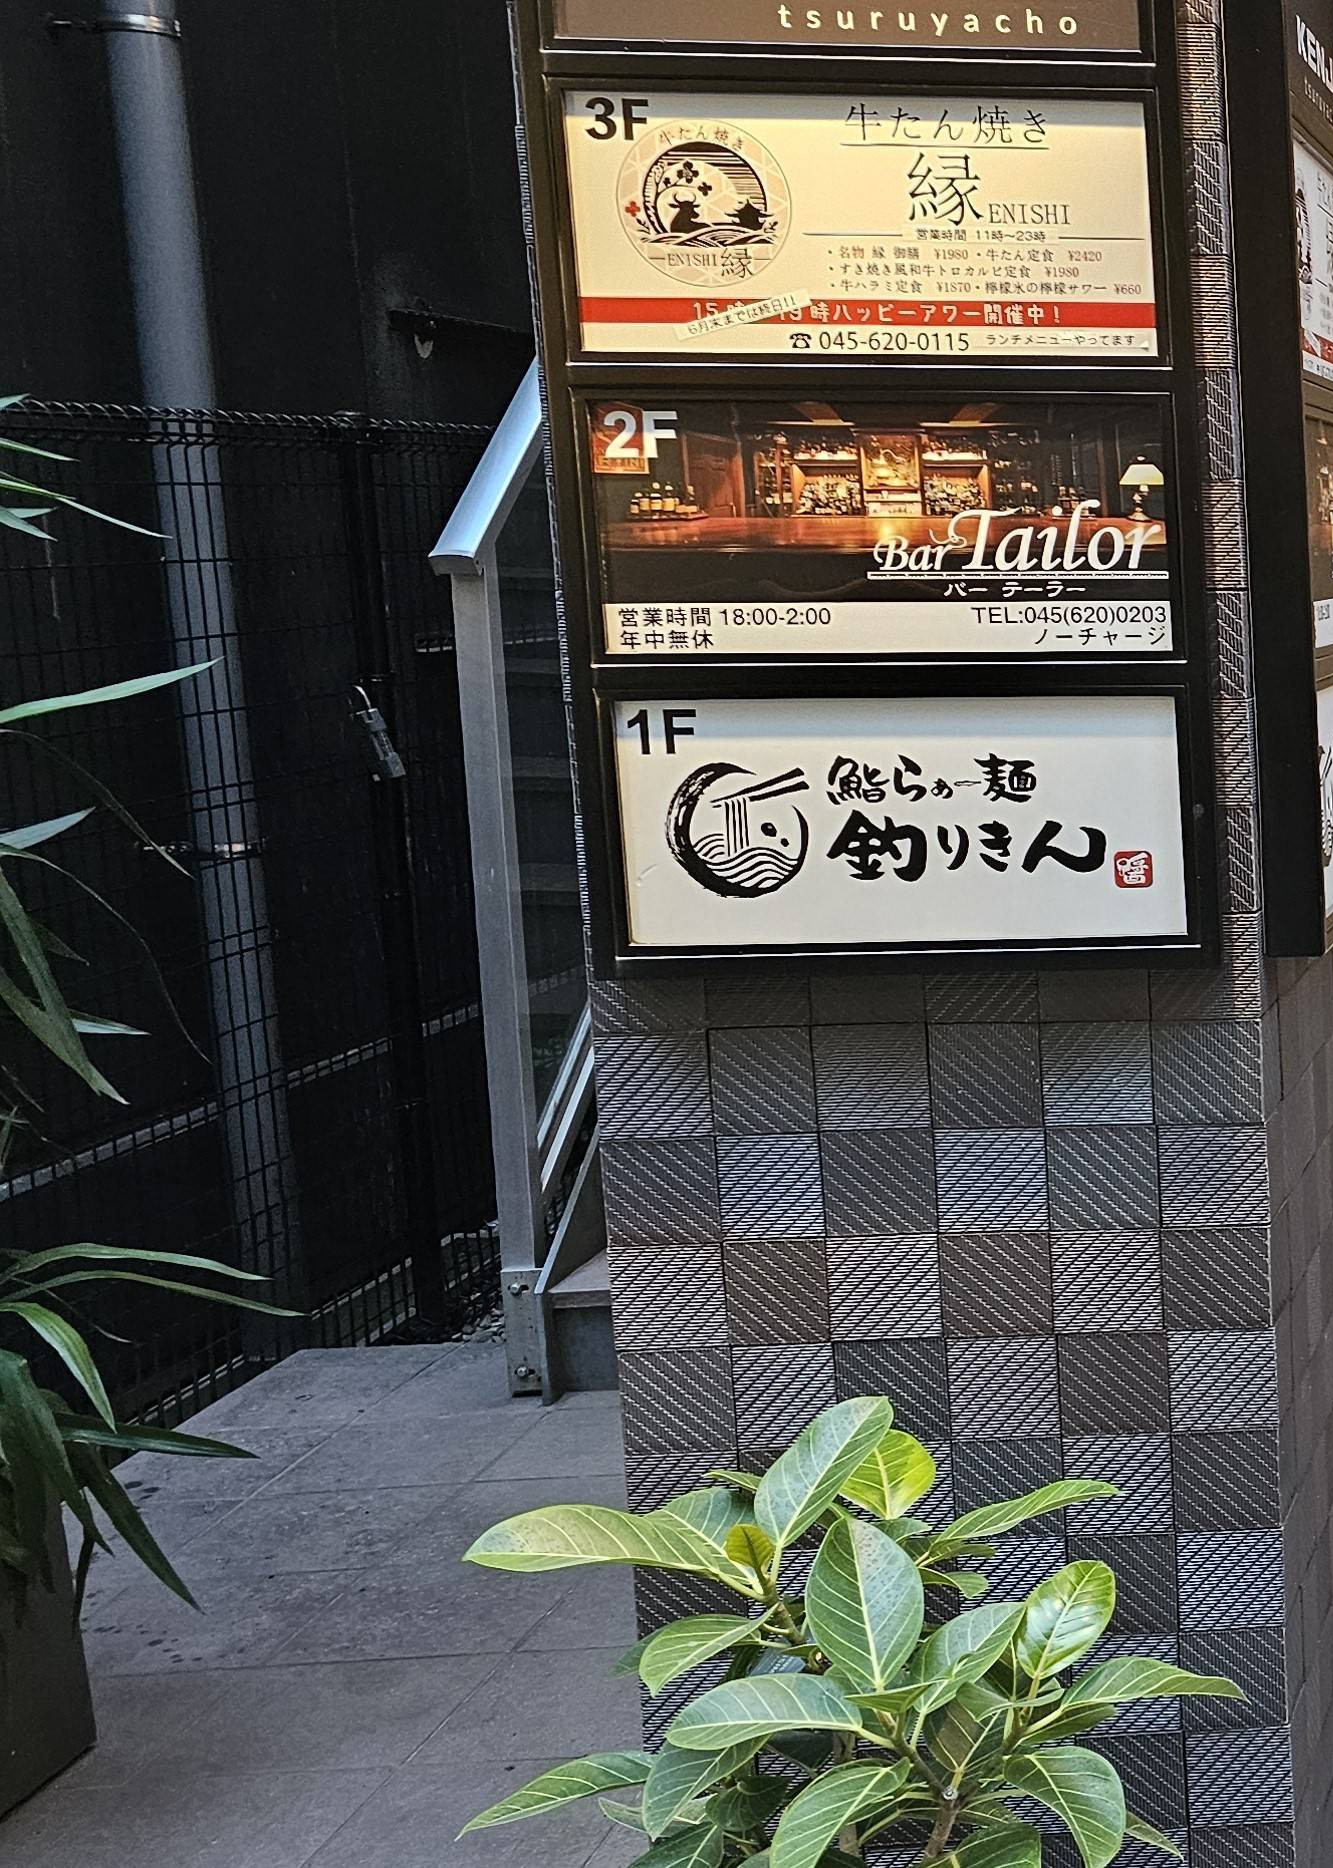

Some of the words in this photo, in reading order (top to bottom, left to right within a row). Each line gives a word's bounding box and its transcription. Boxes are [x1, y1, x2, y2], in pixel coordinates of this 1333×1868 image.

[777, 4, 1078, 36] tsuruyacho
[584, 97, 648, 140] 3F
[845, 103, 1047, 143] 牛たん焼き
[907, 152, 984, 226] 縁
[988, 203, 1071, 225] ENISHI
[916, 229, 966, 241] 営業時間
[667, 253, 718, 267] ENISHI
[721, 247, 754, 278] 縁
[840, 245, 865, 259] 名物
[986, 248, 1054, 262] 牛たん定食
[1068, 250, 1102, 262] ¥2420
[1045, 266, 1080, 278] ¥1980
[936, 282, 971, 293] ¥1870
[1114, 284, 1141, 295] ¥660
[819, 331, 969, 351] 045-620-0115
[986, 334, 1135, 346] ランチメニューやってます
[604, 410, 678, 458] 2F
[874, 535, 952, 571] Bar
[929, 499, 1162, 571] Tailor
[944, 581, 987, 597] バー
[1002, 580, 1087, 597] テーラー
[619, 607, 712, 627] 営業時間
[720, 608, 831, 626] 18:00-2:00
[971, 606, 1167, 627] TEL:045(620)0203
[620, 629, 714, 649] 年中無休
[1034, 626, 1167, 646] ノーチャージ
[626, 708, 697, 755] 1F
[826, 810, 1108, 882] 釣りきん
